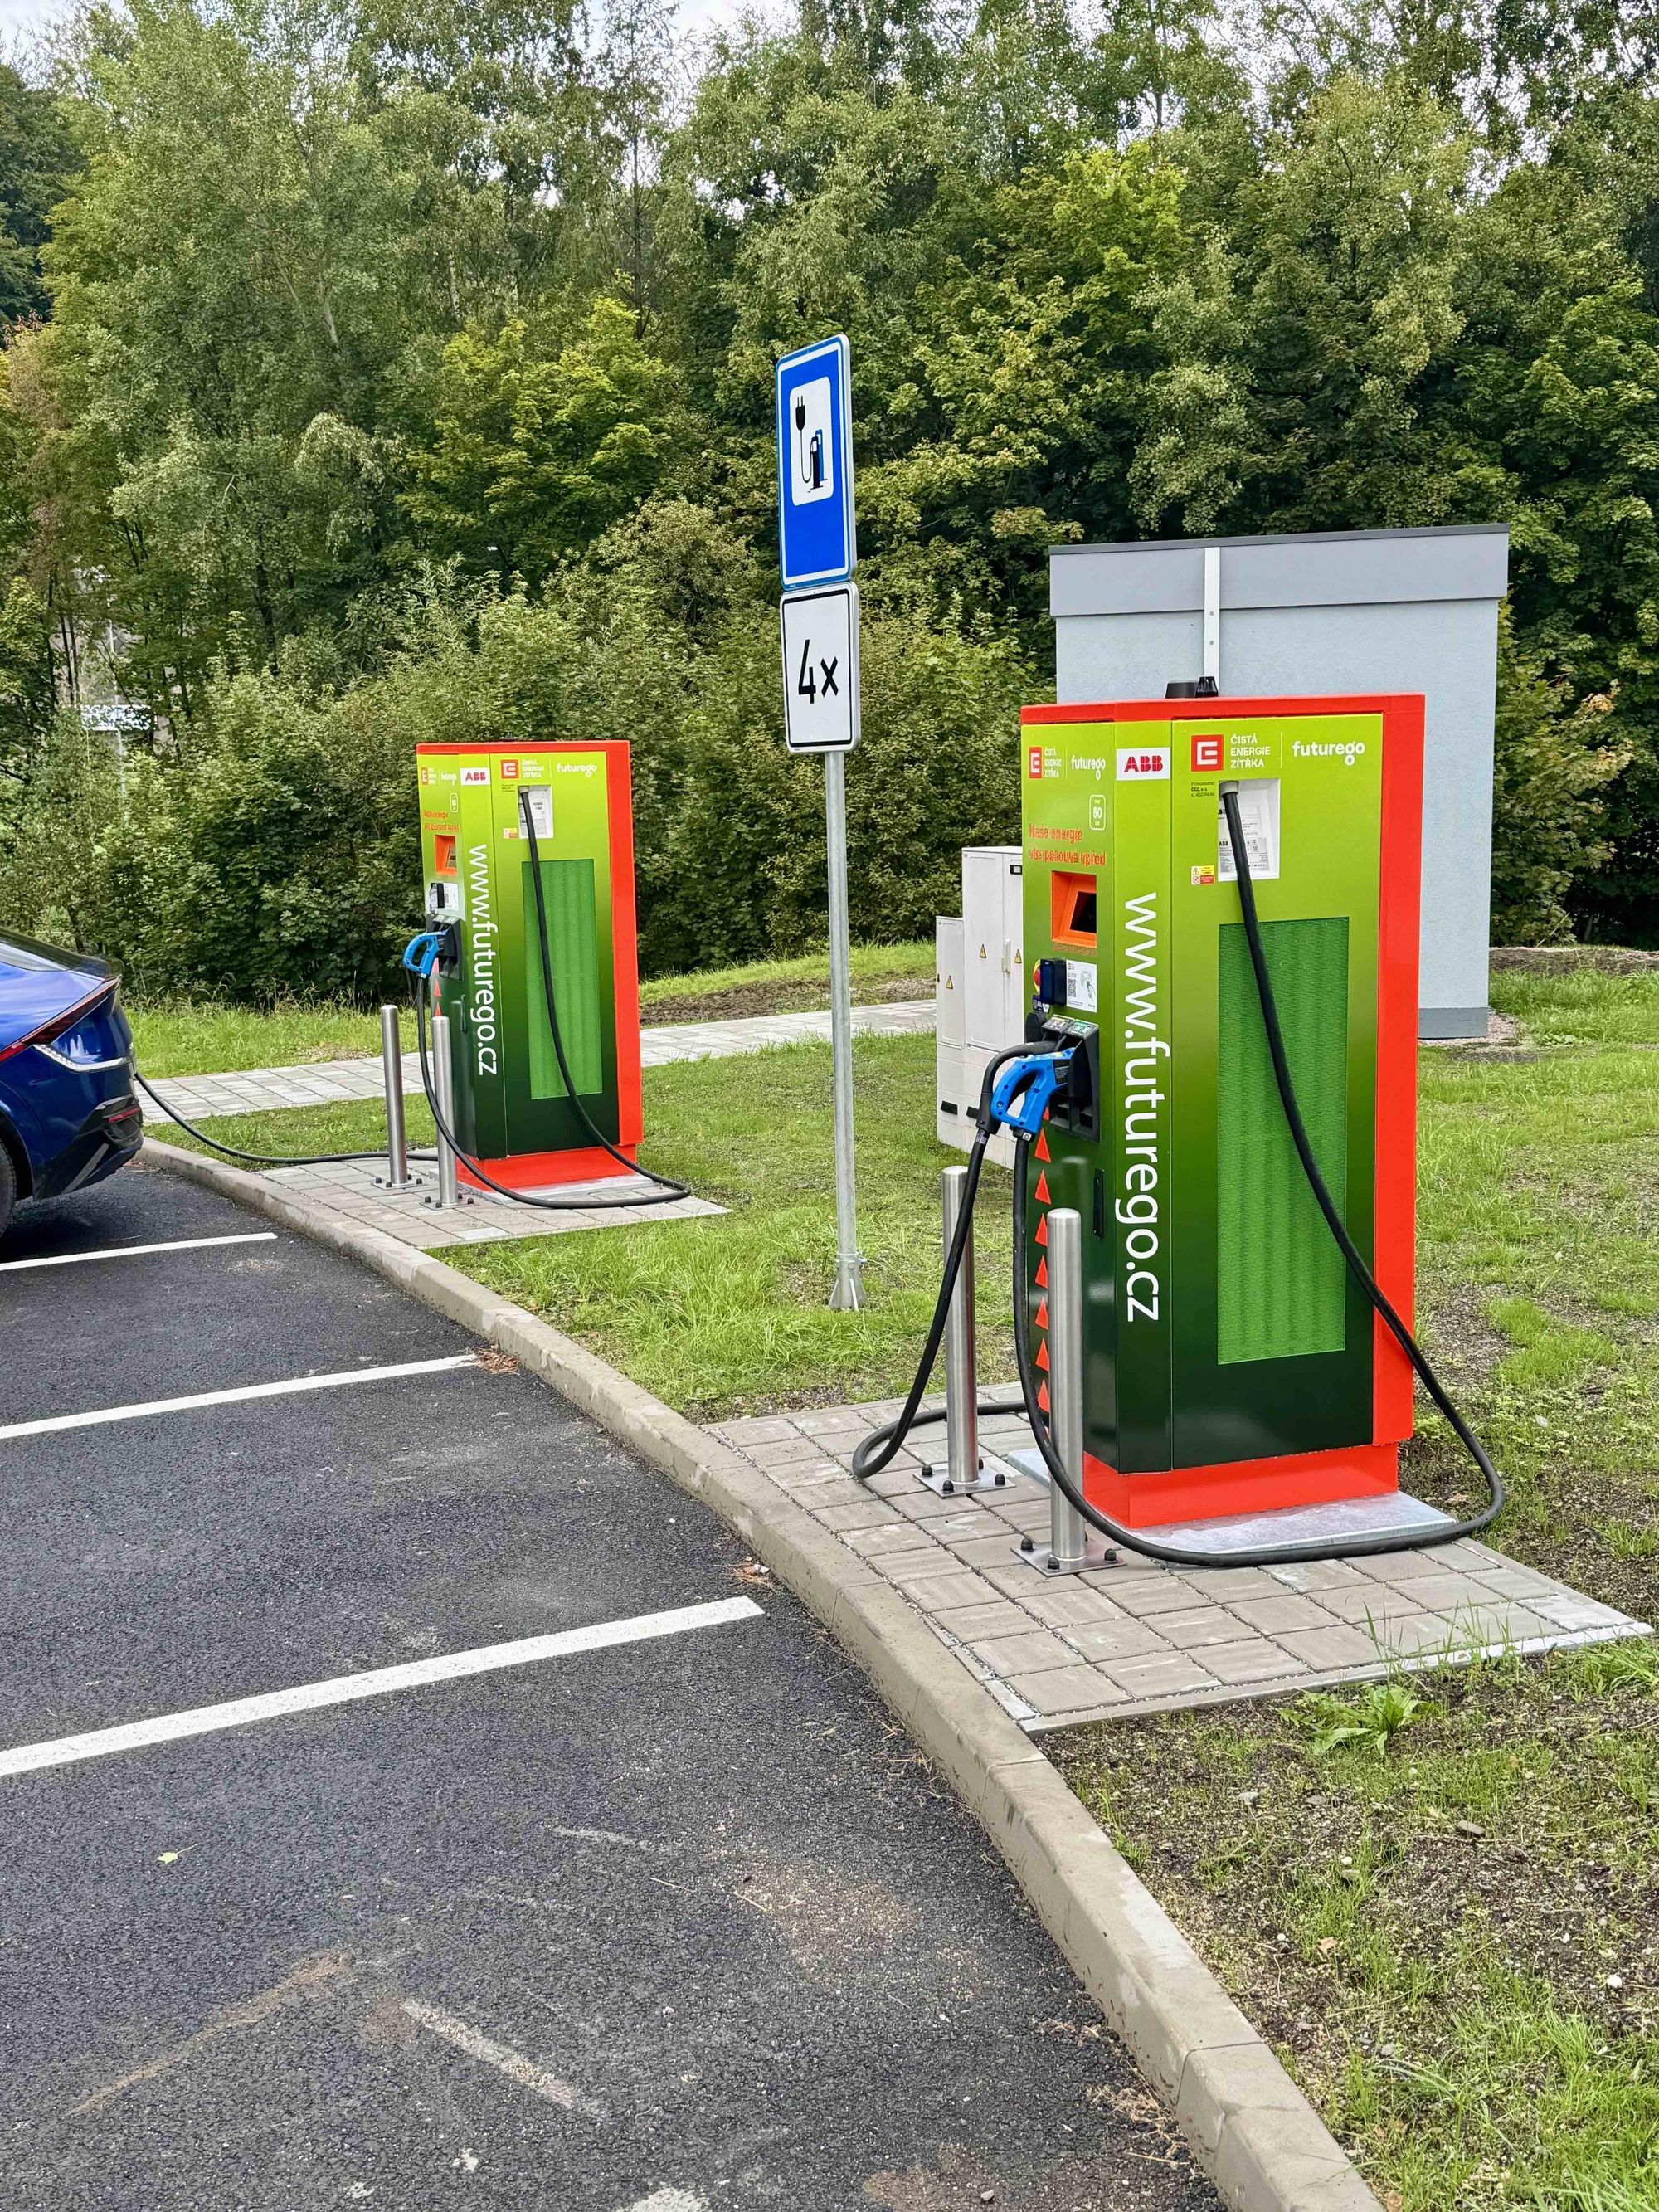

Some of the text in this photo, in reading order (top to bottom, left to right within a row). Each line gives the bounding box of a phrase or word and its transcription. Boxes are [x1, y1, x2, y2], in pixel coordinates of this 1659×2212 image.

[798, 639, 839, 704] 4x
[1230, 733, 1258, 745] ČISTÁ
[1230, 746, 1271, 757] ENERGIE
[1292, 740, 1366, 767] futurego
[556, 763, 597, 777] futurego
[1071, 754, 1107, 781] futurego
[1124, 755, 1164, 772] ABB
[1230, 758, 1265, 769] ZÍTŘKA
[465, 772, 487, 781] ABB
[469, 844, 499, 1075] www.futurego.cz
[1115, 892, 1170, 1323] www.futurego.cz
